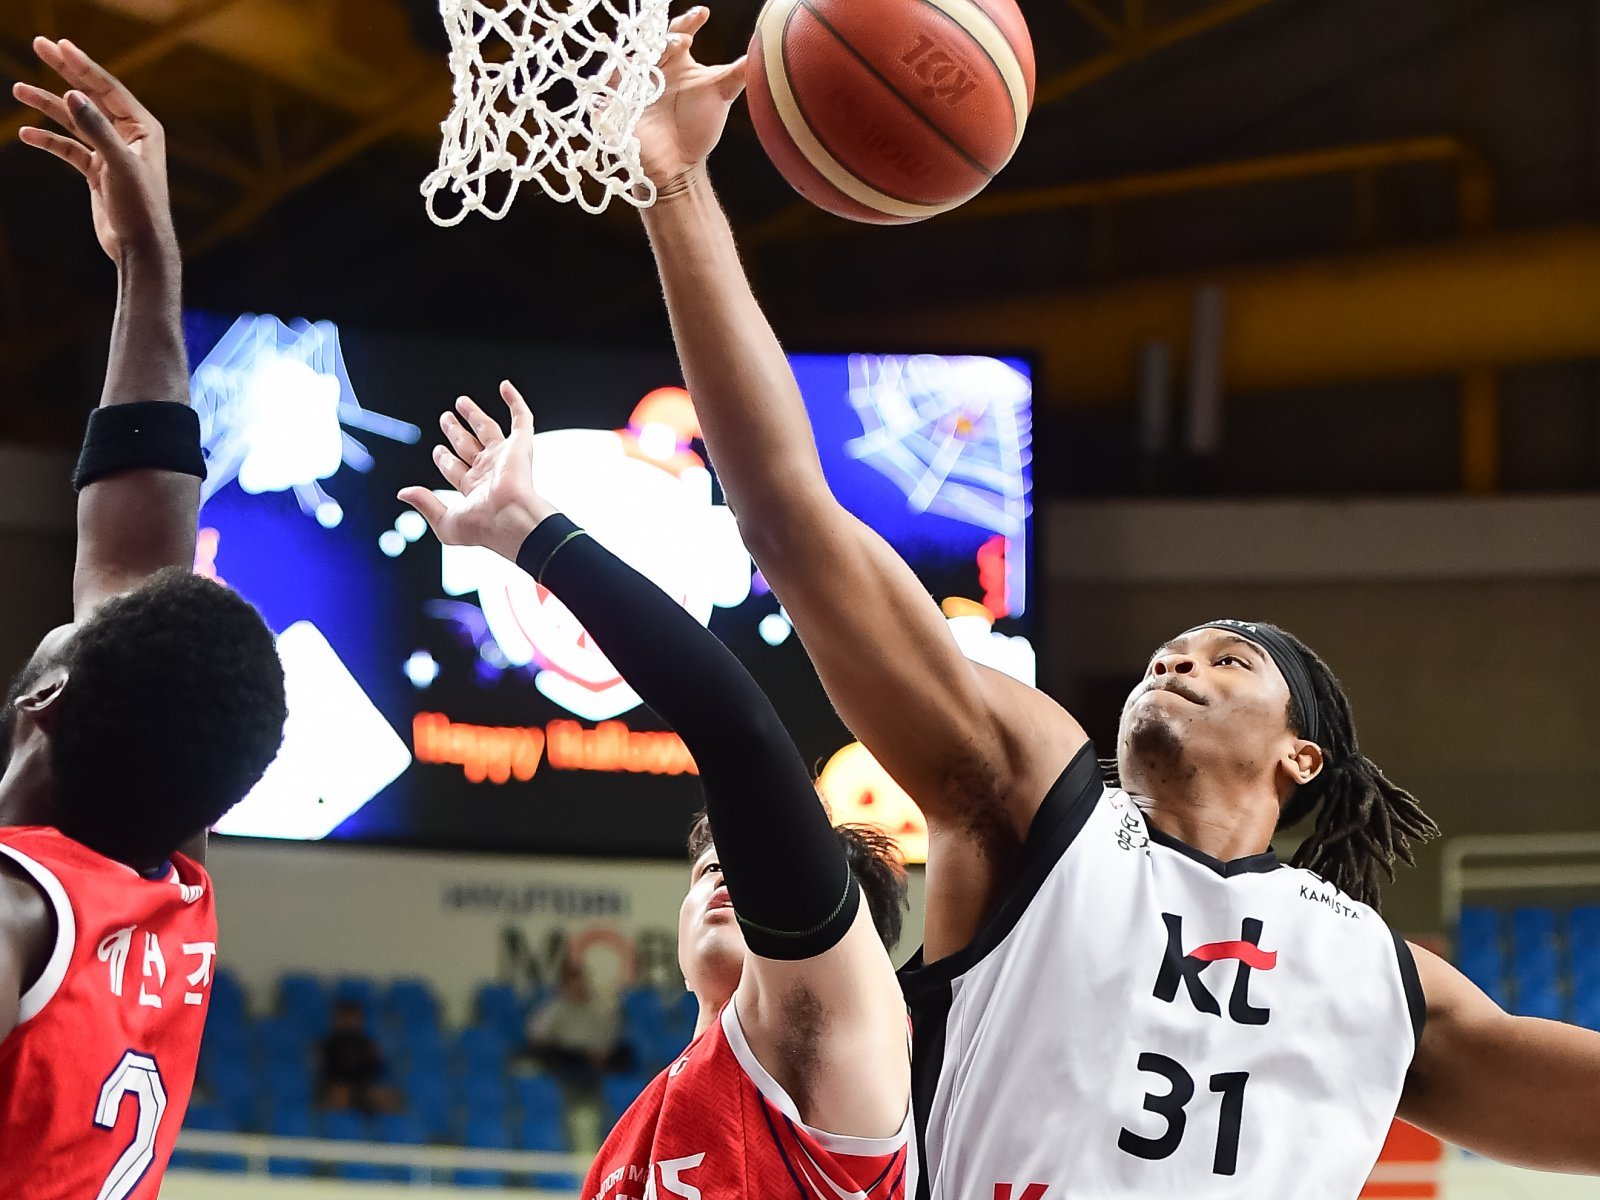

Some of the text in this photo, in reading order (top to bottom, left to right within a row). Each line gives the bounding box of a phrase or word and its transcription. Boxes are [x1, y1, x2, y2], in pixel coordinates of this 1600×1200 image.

[1300, 885, 1360, 919] KAMISTA
[1152, 912, 1278, 1026] kt
[1117, 1052, 1250, 1177] 31
